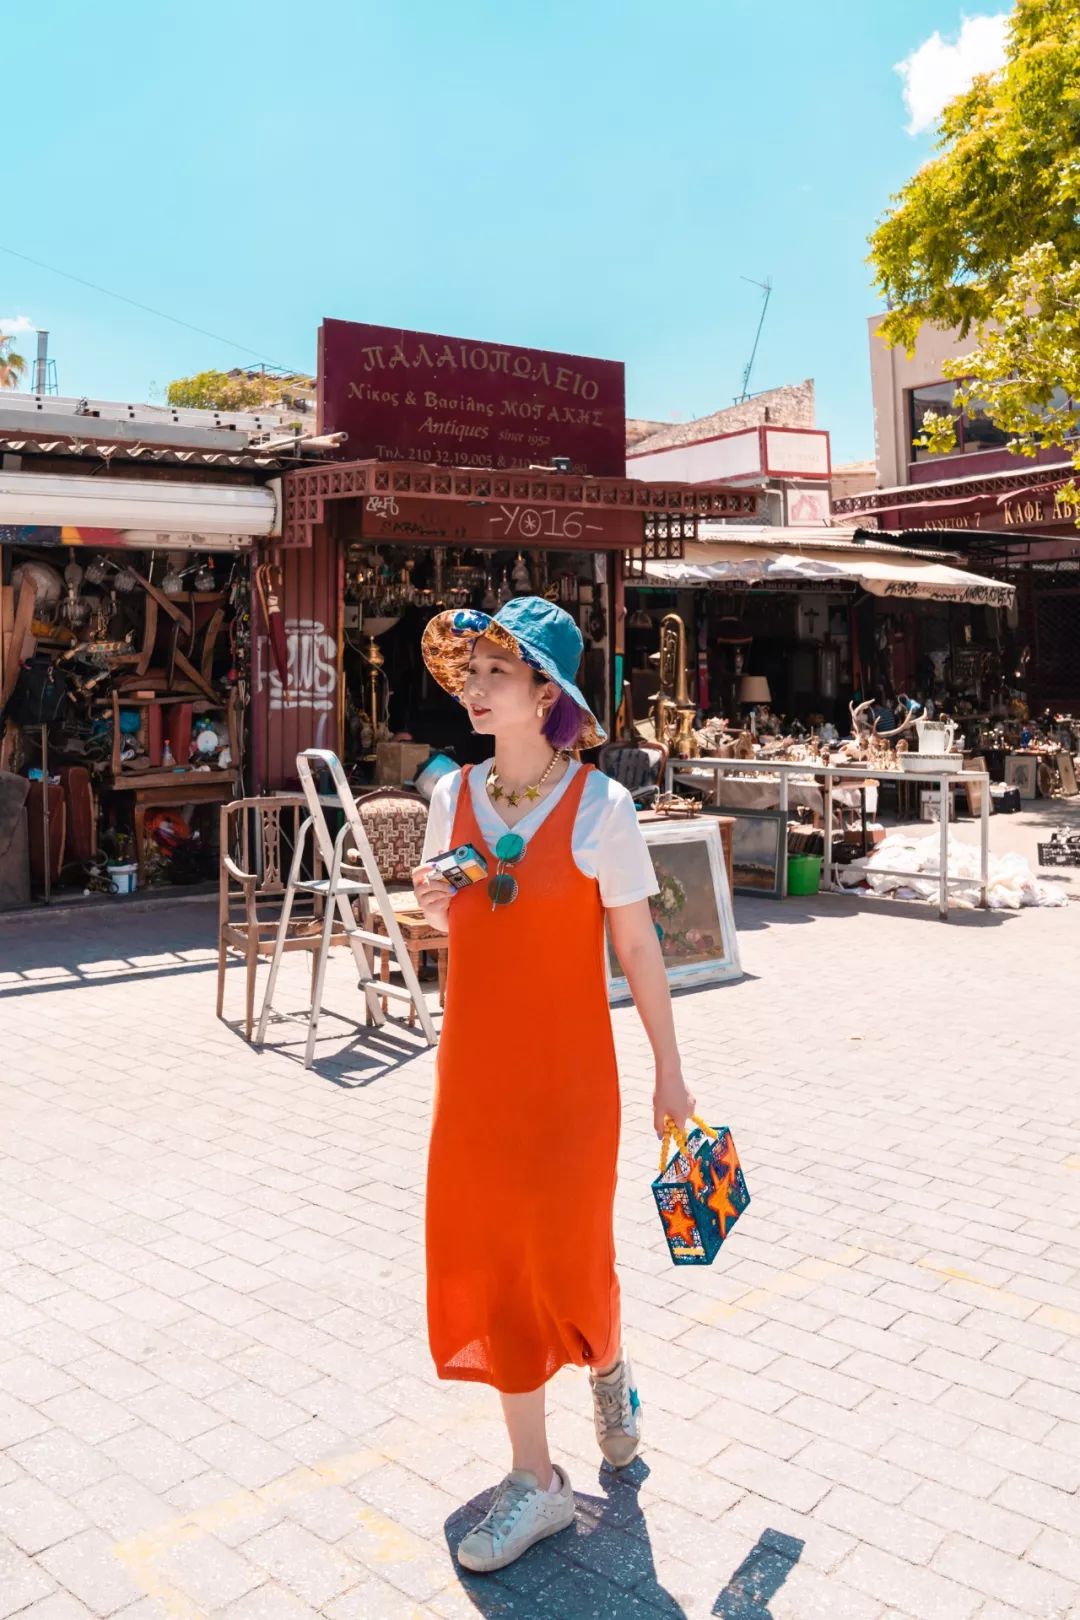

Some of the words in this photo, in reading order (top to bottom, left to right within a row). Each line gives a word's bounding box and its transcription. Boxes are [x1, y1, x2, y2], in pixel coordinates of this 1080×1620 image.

[361, 343, 599, 400] ΠΑΛΑΙΟΠΩΛΕΙΟ
[404, 390, 417, 405] &
[418, 416, 489, 442] Antiques
[498, 428, 524, 442] since
[408, 448, 432, 461] 210
[974, 512, 981, 528] 7
[1004, 500, 1045, 525] ΚΑΦΕ
